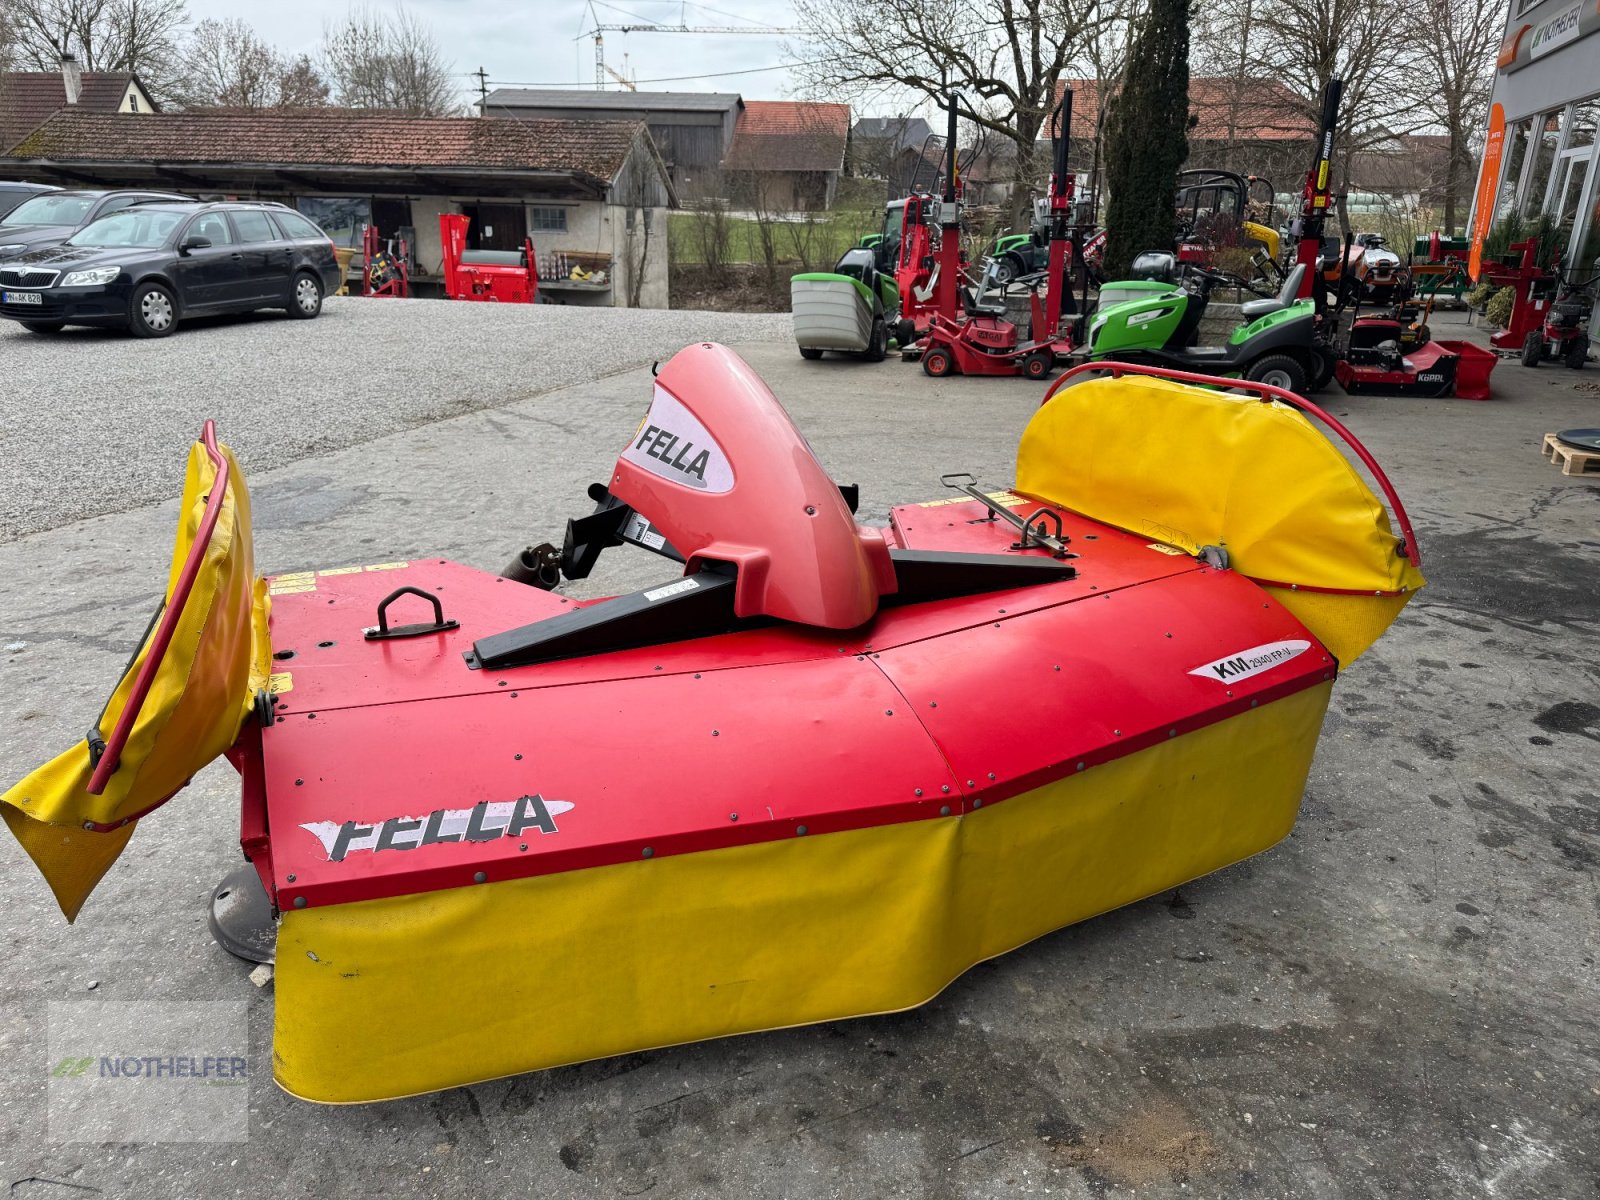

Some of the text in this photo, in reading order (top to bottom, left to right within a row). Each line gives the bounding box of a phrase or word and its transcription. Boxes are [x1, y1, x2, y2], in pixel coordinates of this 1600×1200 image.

[636, 425, 710, 481] FELLA
[1213, 657, 1252, 679] KM
[1249, 655, 1271, 668] 2940
[329, 794, 558, 862] FELLA
